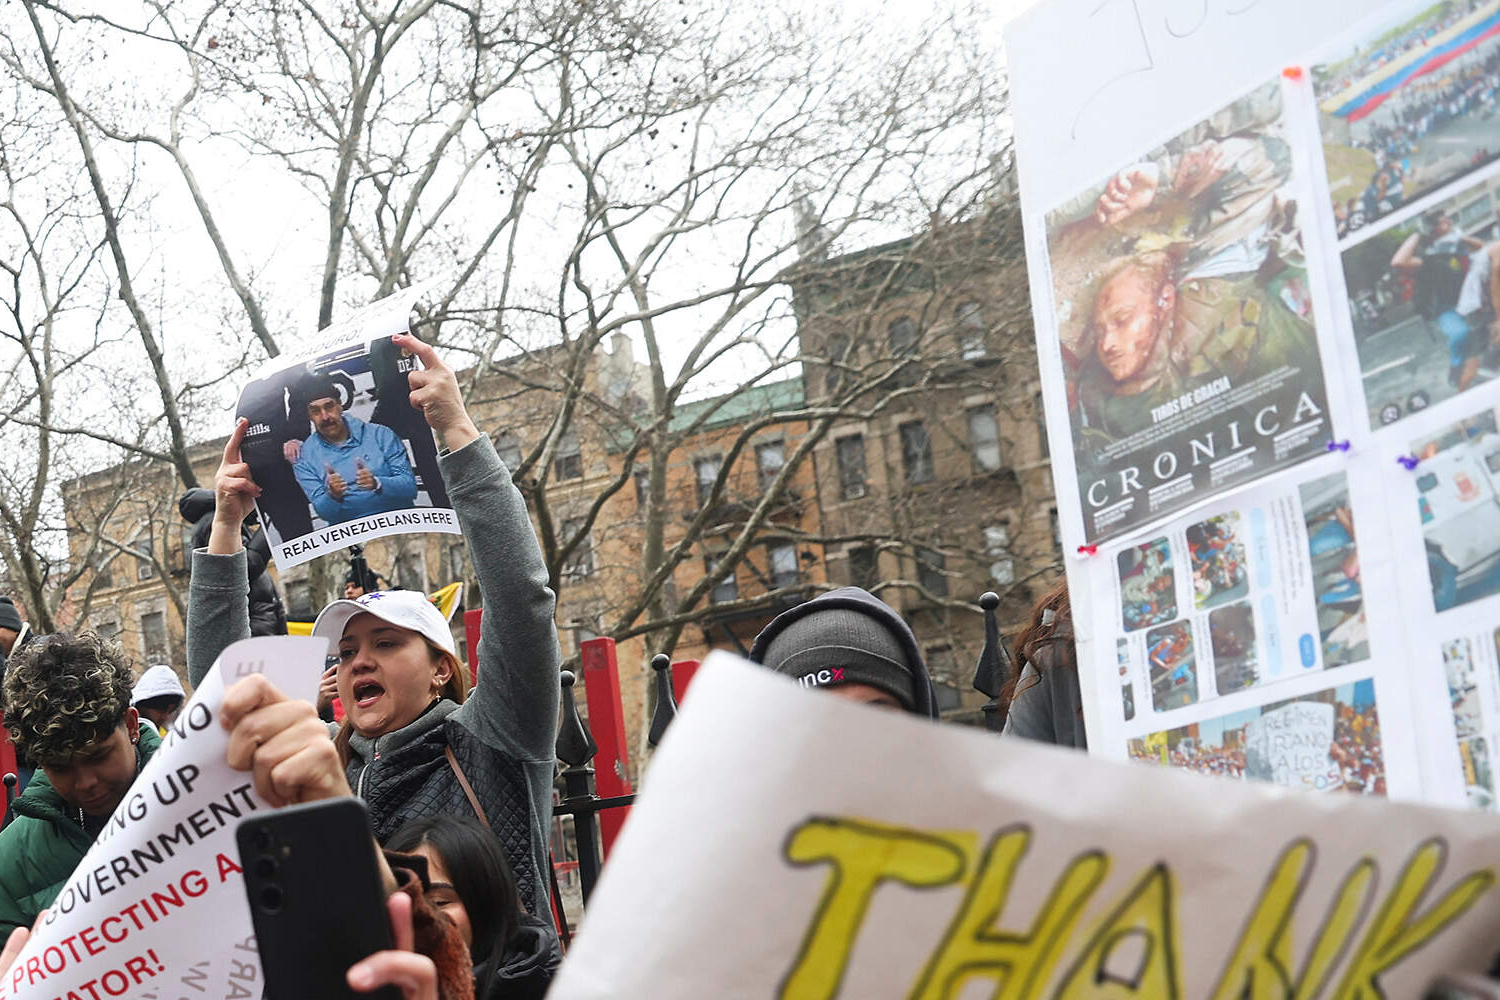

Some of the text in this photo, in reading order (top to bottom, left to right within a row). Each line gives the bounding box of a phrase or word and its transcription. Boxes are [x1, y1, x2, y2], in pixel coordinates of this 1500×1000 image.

[1151, 400, 1180, 424] TIROS
[1180, 394, 1194, 411] DE
[1194, 376, 1232, 405] GRACIA
[282, 512, 453, 560] REAL VENEZUELANS HERE
[153, 763, 200, 806] UP
[45, 783, 257, 926] GOVERNMENT
[13, 868, 210, 993] PROTECTING
[216, 852, 243, 882] A
